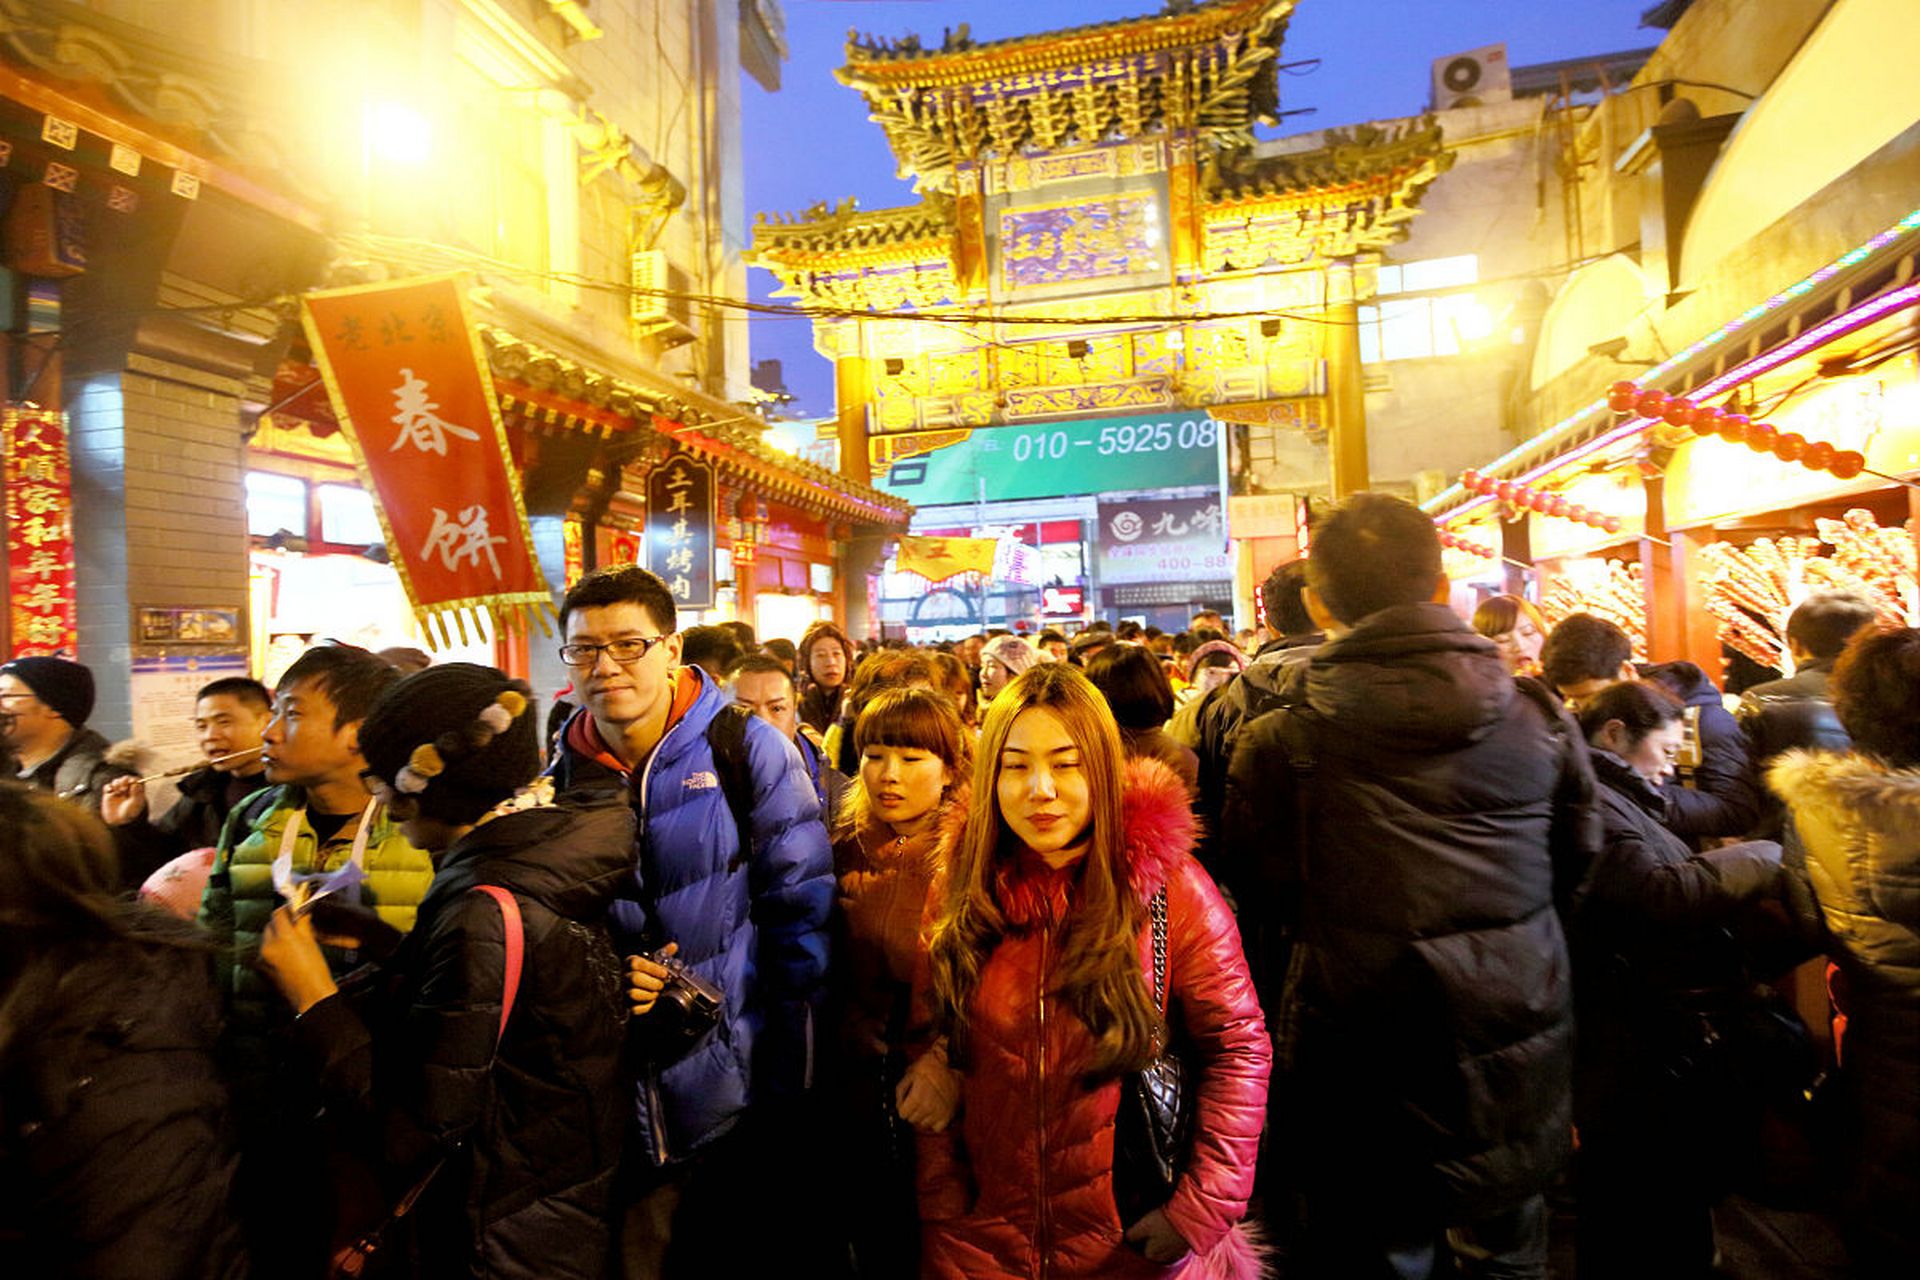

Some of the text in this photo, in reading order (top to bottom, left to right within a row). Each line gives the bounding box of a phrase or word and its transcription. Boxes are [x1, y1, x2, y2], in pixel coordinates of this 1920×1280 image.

[665, 467, 695, 600] 土耳其烤肉
